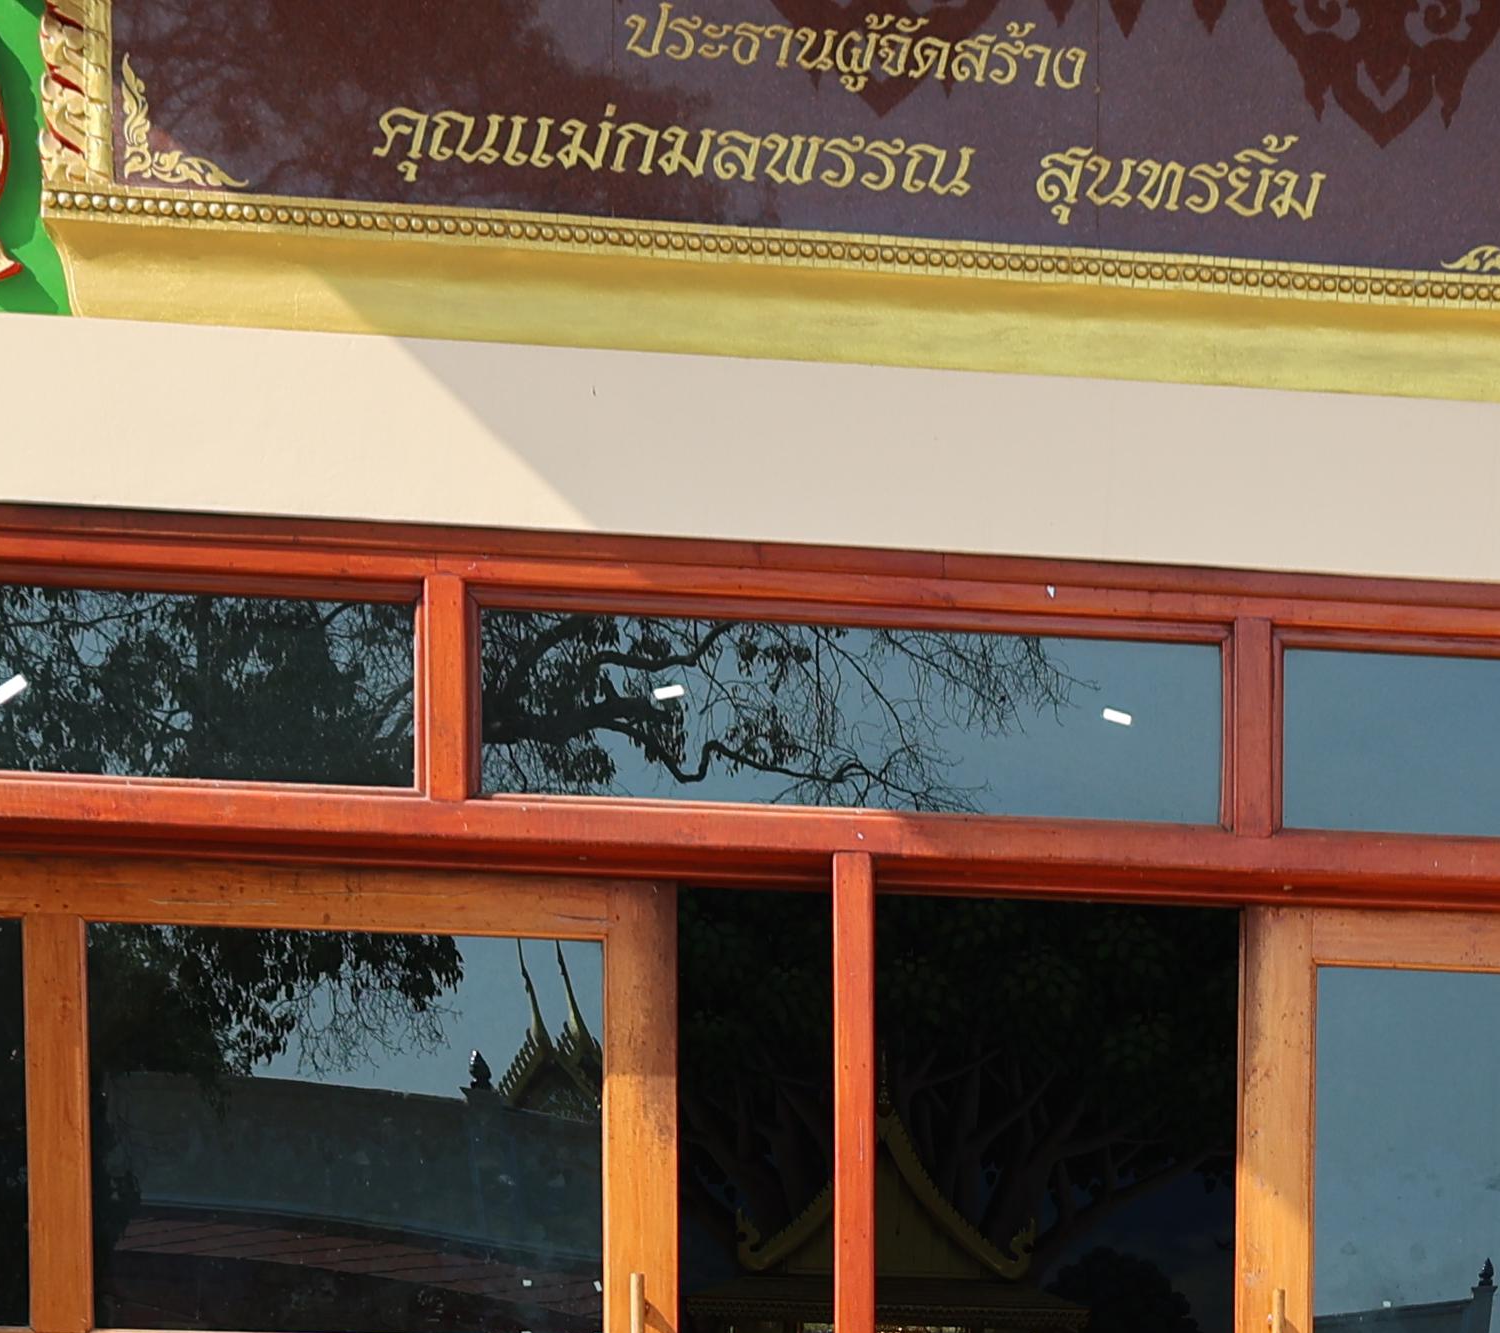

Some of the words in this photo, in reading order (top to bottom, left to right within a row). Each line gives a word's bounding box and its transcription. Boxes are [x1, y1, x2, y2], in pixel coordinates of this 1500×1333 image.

[625, 2, 1088, 92] ประธานผู้จัดสร้าง
[373, 104, 975, 197] คุณแม่กมลพรรณ
[1036, 134, 1326, 225] สุนทรยิ้ม
